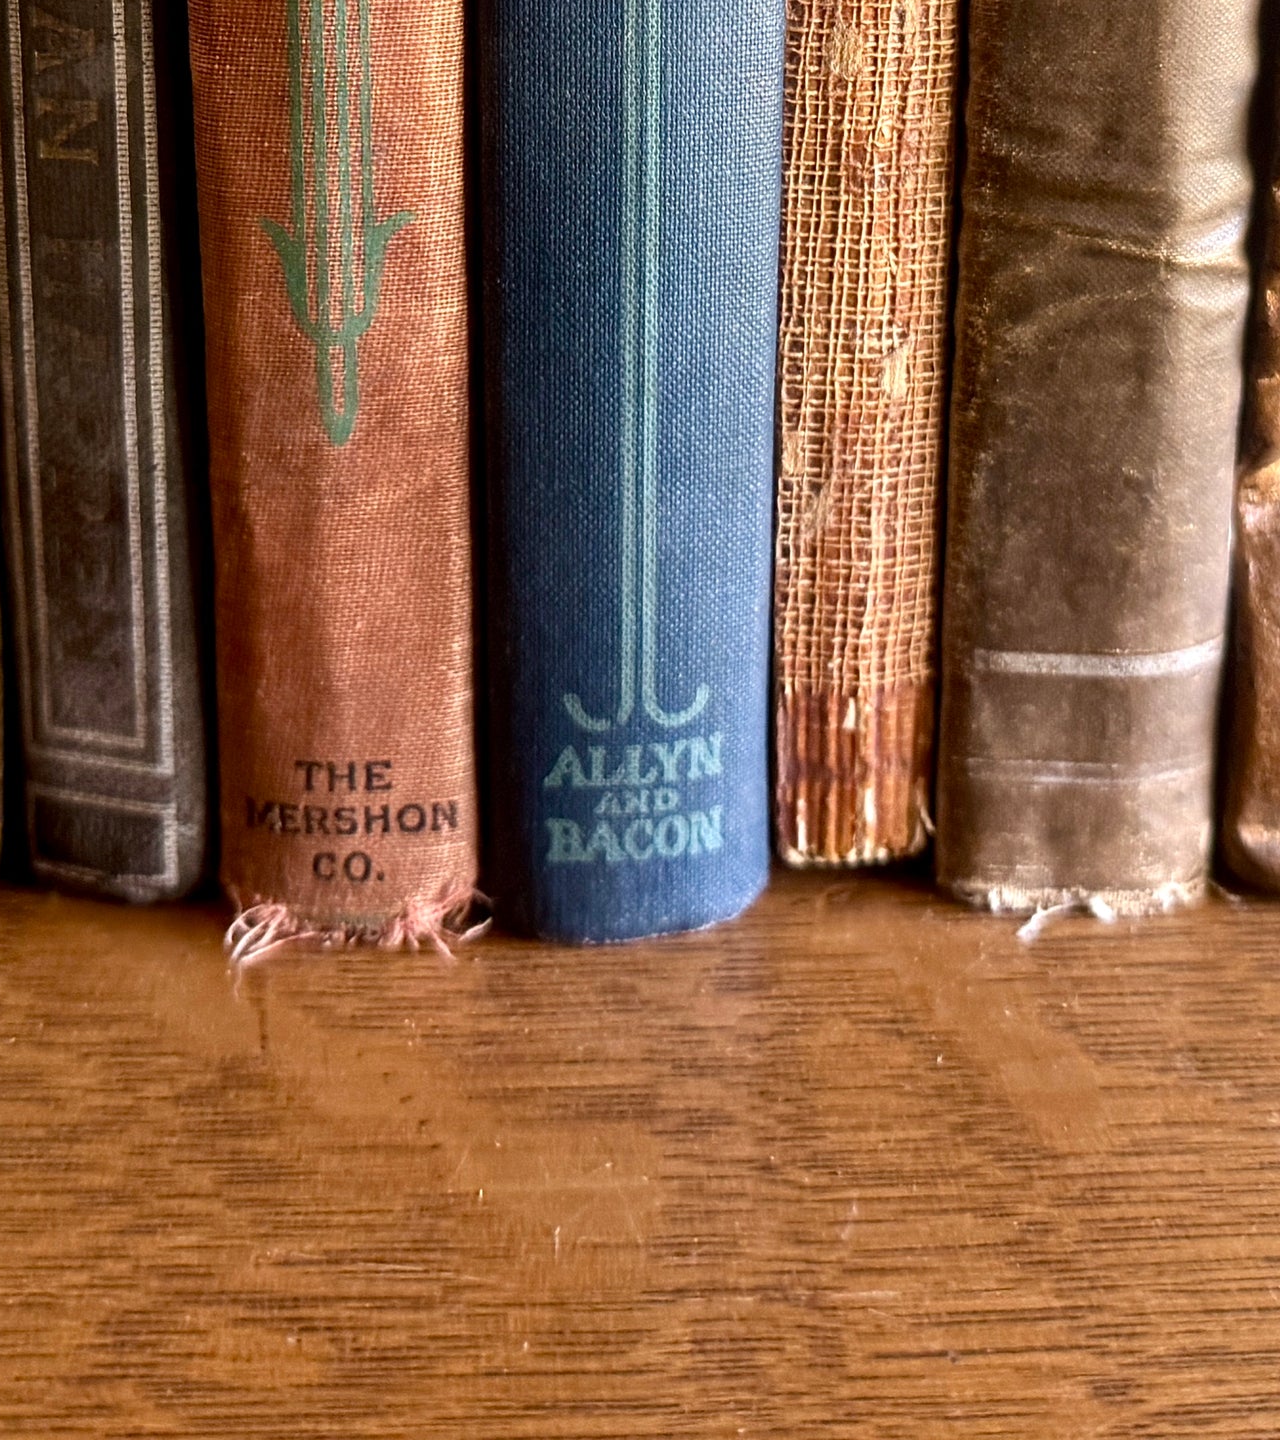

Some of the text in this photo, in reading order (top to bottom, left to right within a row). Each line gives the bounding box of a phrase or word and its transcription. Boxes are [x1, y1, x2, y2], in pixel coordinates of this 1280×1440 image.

[294, 759, 393, 793] THE
[542, 730, 725, 788] ALLYN
[245, 796, 459, 837] MERSHON
[592, 787, 680, 815] AND
[543, 803, 725, 862] BACON
[312, 850, 385, 883] CO.
